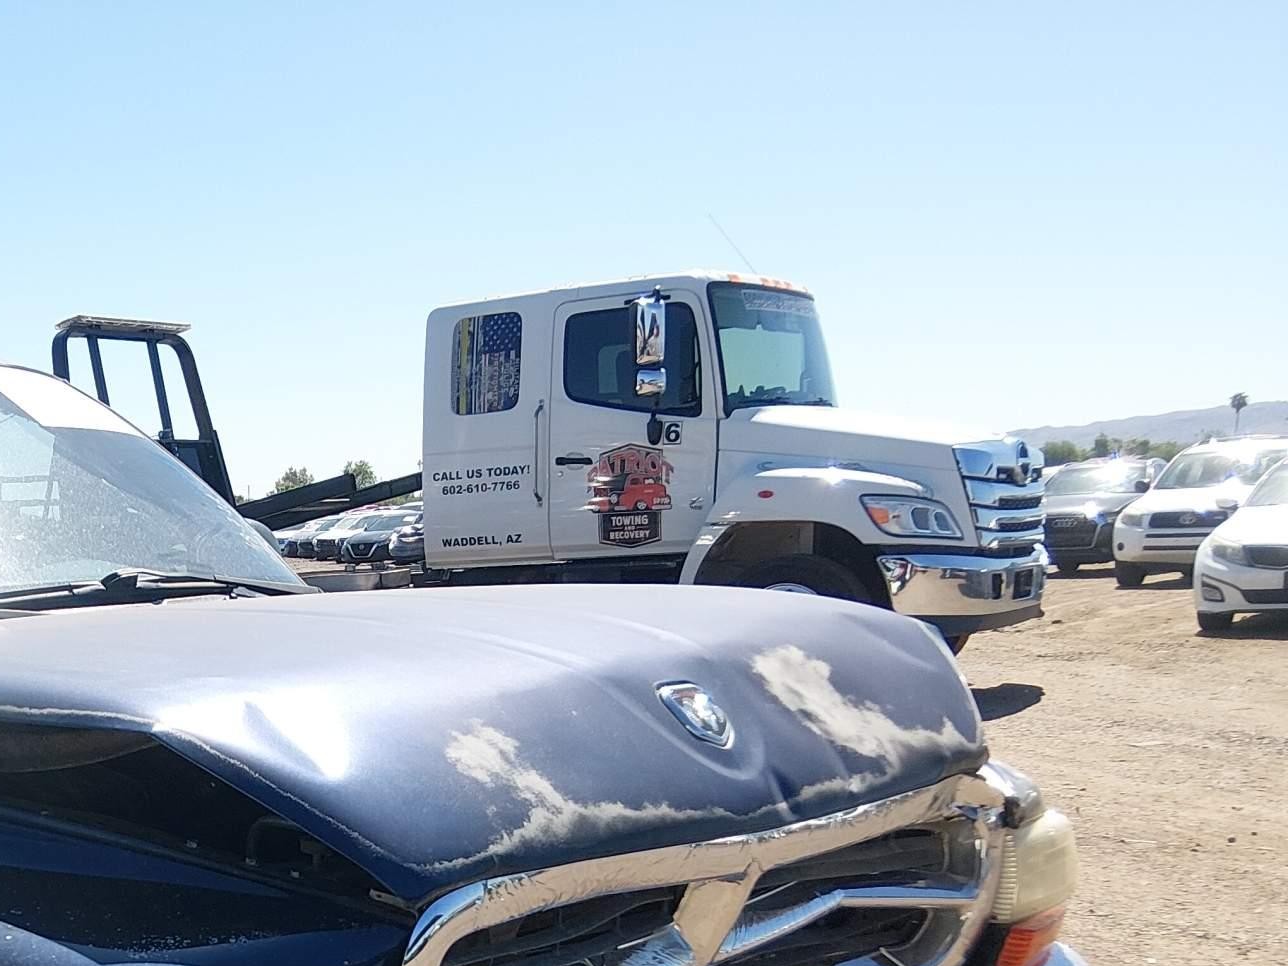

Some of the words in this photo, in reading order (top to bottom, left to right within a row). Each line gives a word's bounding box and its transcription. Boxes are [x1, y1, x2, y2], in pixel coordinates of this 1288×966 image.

[665, 422, 680, 442] 6
[432, 471, 463, 482] CALL
[466, 468, 483, 480] US
[486, 464, 531, 478] TODAY!
[442, 480, 521, 496] 602-610-7766
[610, 514, 649, 527] TOWING
[441, 535, 503, 548] WADDELL,
[506, 533, 522, 544] AZ
[609, 529, 651, 540] RECOVERY
